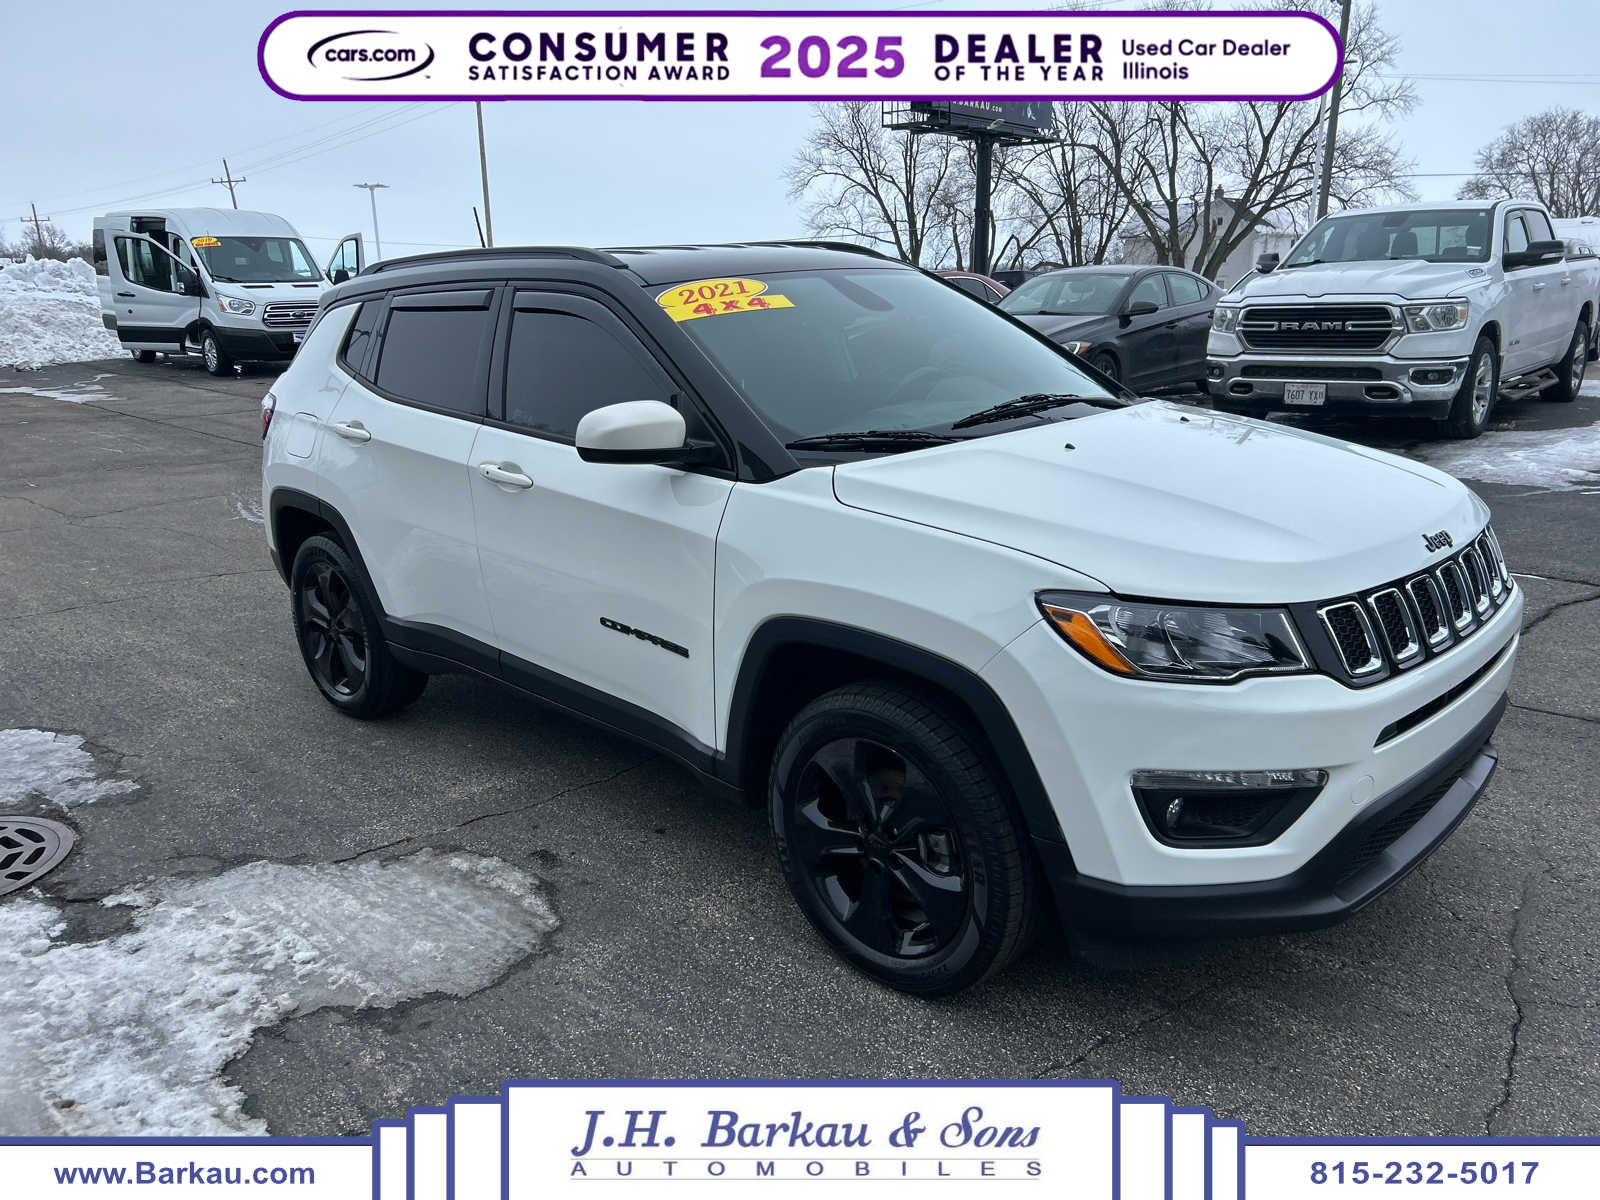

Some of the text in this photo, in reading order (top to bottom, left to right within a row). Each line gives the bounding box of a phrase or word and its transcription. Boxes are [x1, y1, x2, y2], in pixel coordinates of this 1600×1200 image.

[678, 280, 750, 305] 2021
[1280, 321, 1343, 331] RAM
[1421, 529, 1454, 553] Jeep
